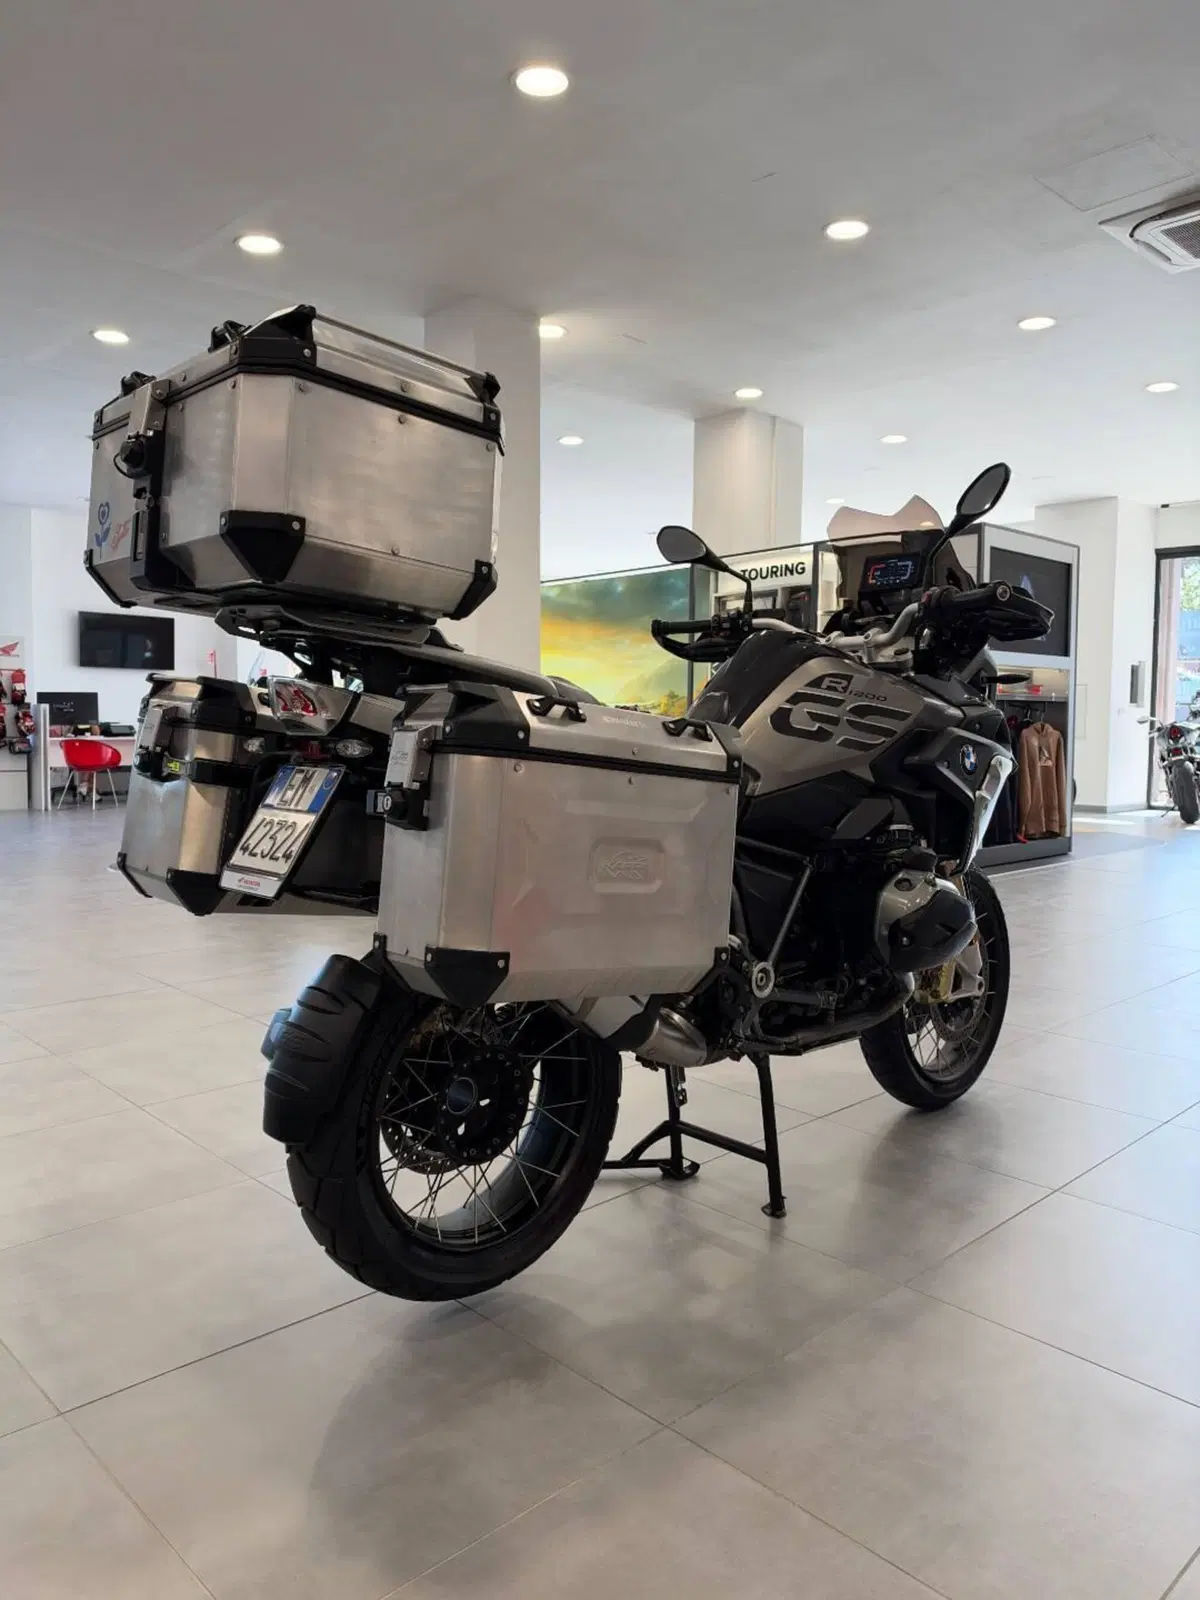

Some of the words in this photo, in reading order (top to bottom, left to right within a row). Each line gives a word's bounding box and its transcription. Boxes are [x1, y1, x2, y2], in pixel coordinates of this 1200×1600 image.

[740, 562, 806, 582] TOURING
[821, 676, 848, 695] R
[848, 689, 888, 702] 1200
[768, 689, 913, 753] GS
[276, 768, 318, 807] EM
[240, 817, 312, 864] 42324
